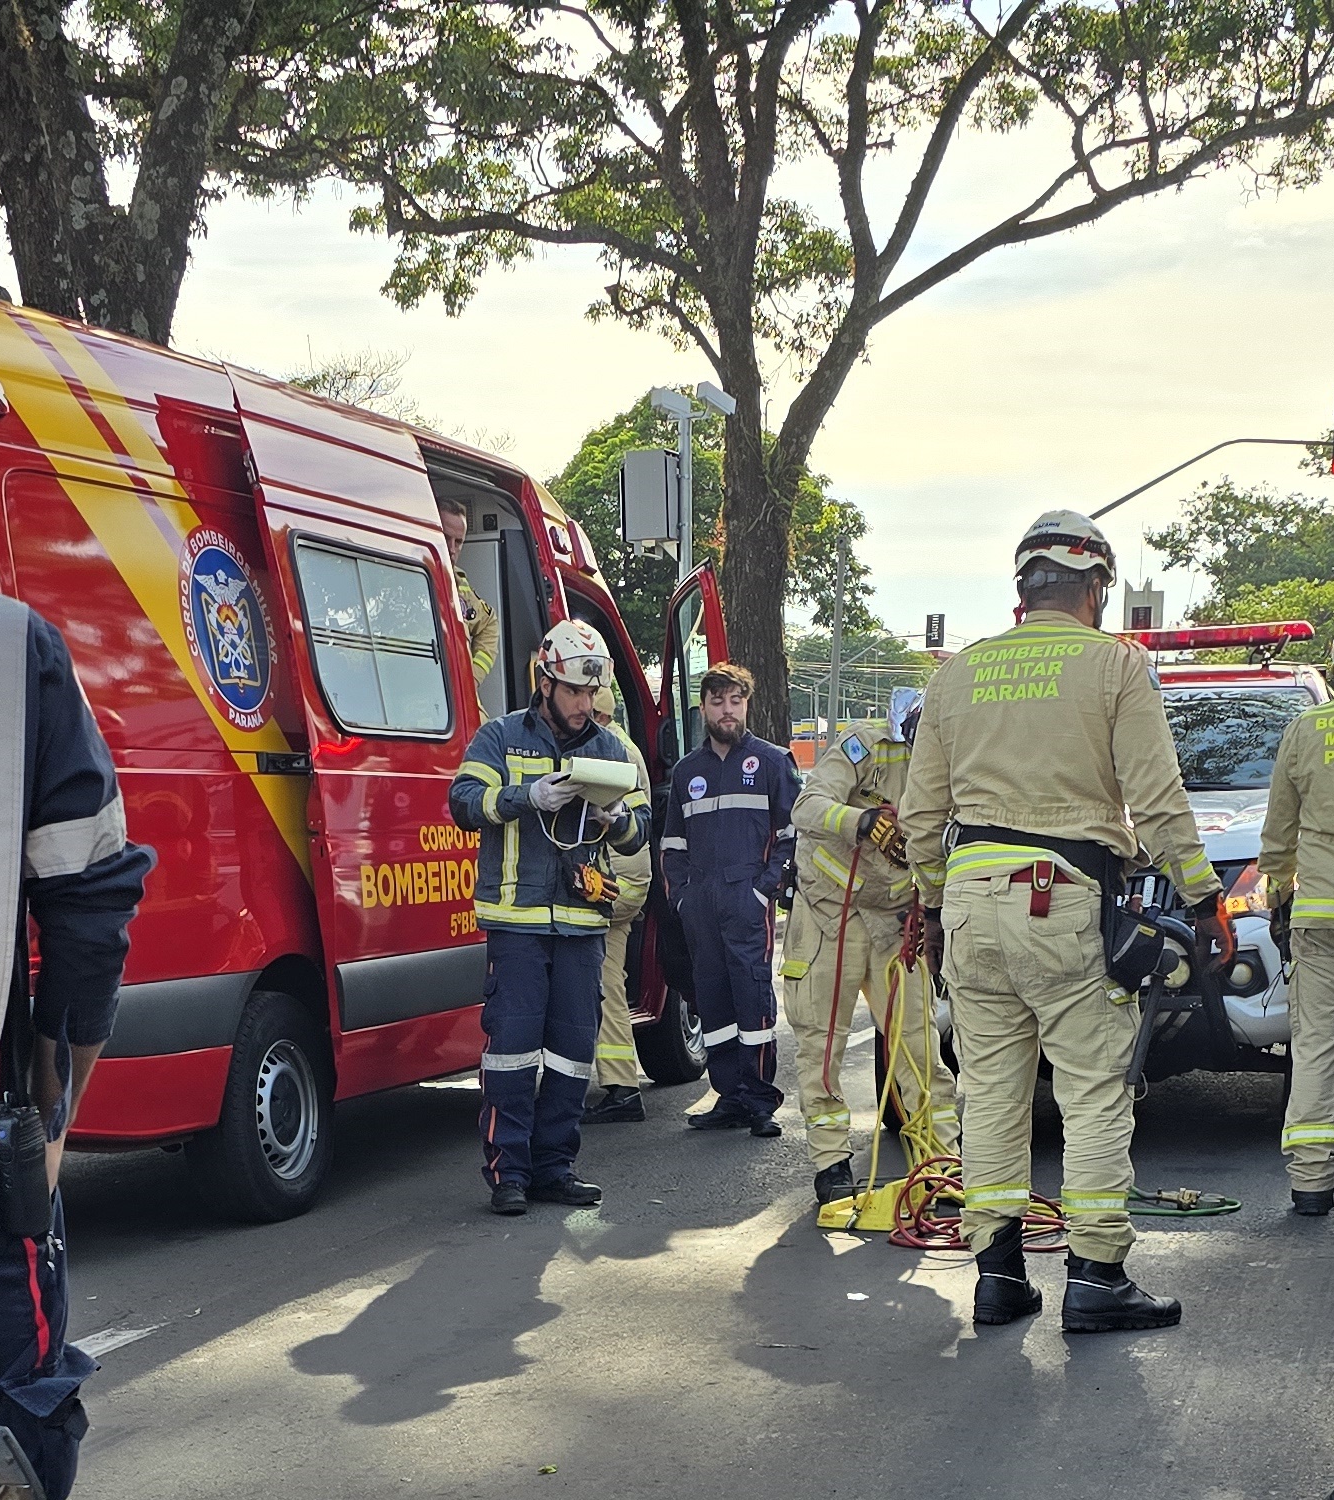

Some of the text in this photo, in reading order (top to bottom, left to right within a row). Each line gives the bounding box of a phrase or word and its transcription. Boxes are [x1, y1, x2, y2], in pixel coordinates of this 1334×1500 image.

[180, 529, 278, 665] CORPO DE BOMBEIROS MILITAR
[967, 643, 1085, 667] BOMBEIRO
[973, 660, 1064, 683] MILITAR
[971, 676, 1059, 704] PARANÁ
[229, 707, 264, 728] PARANÁ
[420, 825, 464, 852] CORPO
